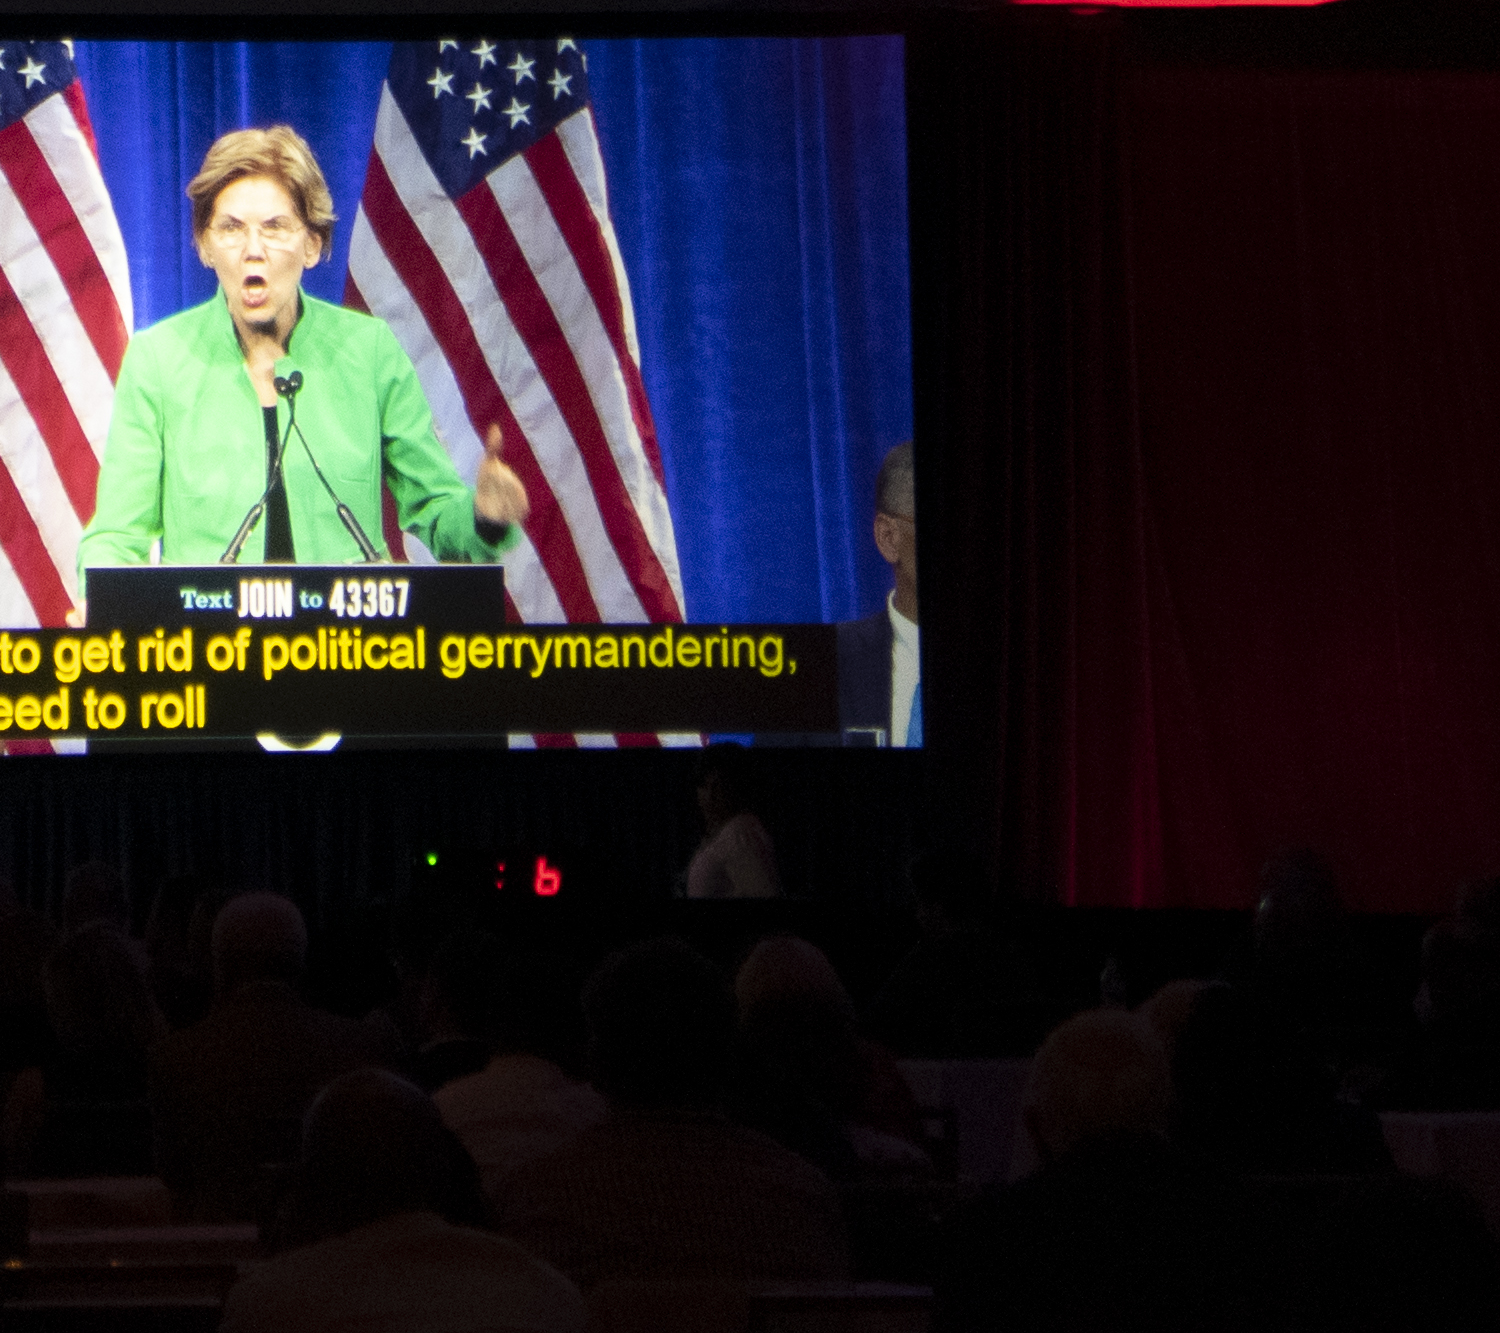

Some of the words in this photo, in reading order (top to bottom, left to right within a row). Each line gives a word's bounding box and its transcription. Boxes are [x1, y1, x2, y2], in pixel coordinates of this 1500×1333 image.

[180, 589, 233, 609] Text
[238, 579, 294, 619] JOIN
[299, 591, 324, 609] to
[329, 580, 410, 618] 43367
[53, 633, 128, 687] get
[138, 629, 193, 672] rid
[206, 629, 253, 672] of
[263, 629, 426, 681] political
[440, 629, 798, 680] gerrymandering,
[82, 690, 128, 731] to
[140, 685, 207, 730] roll
